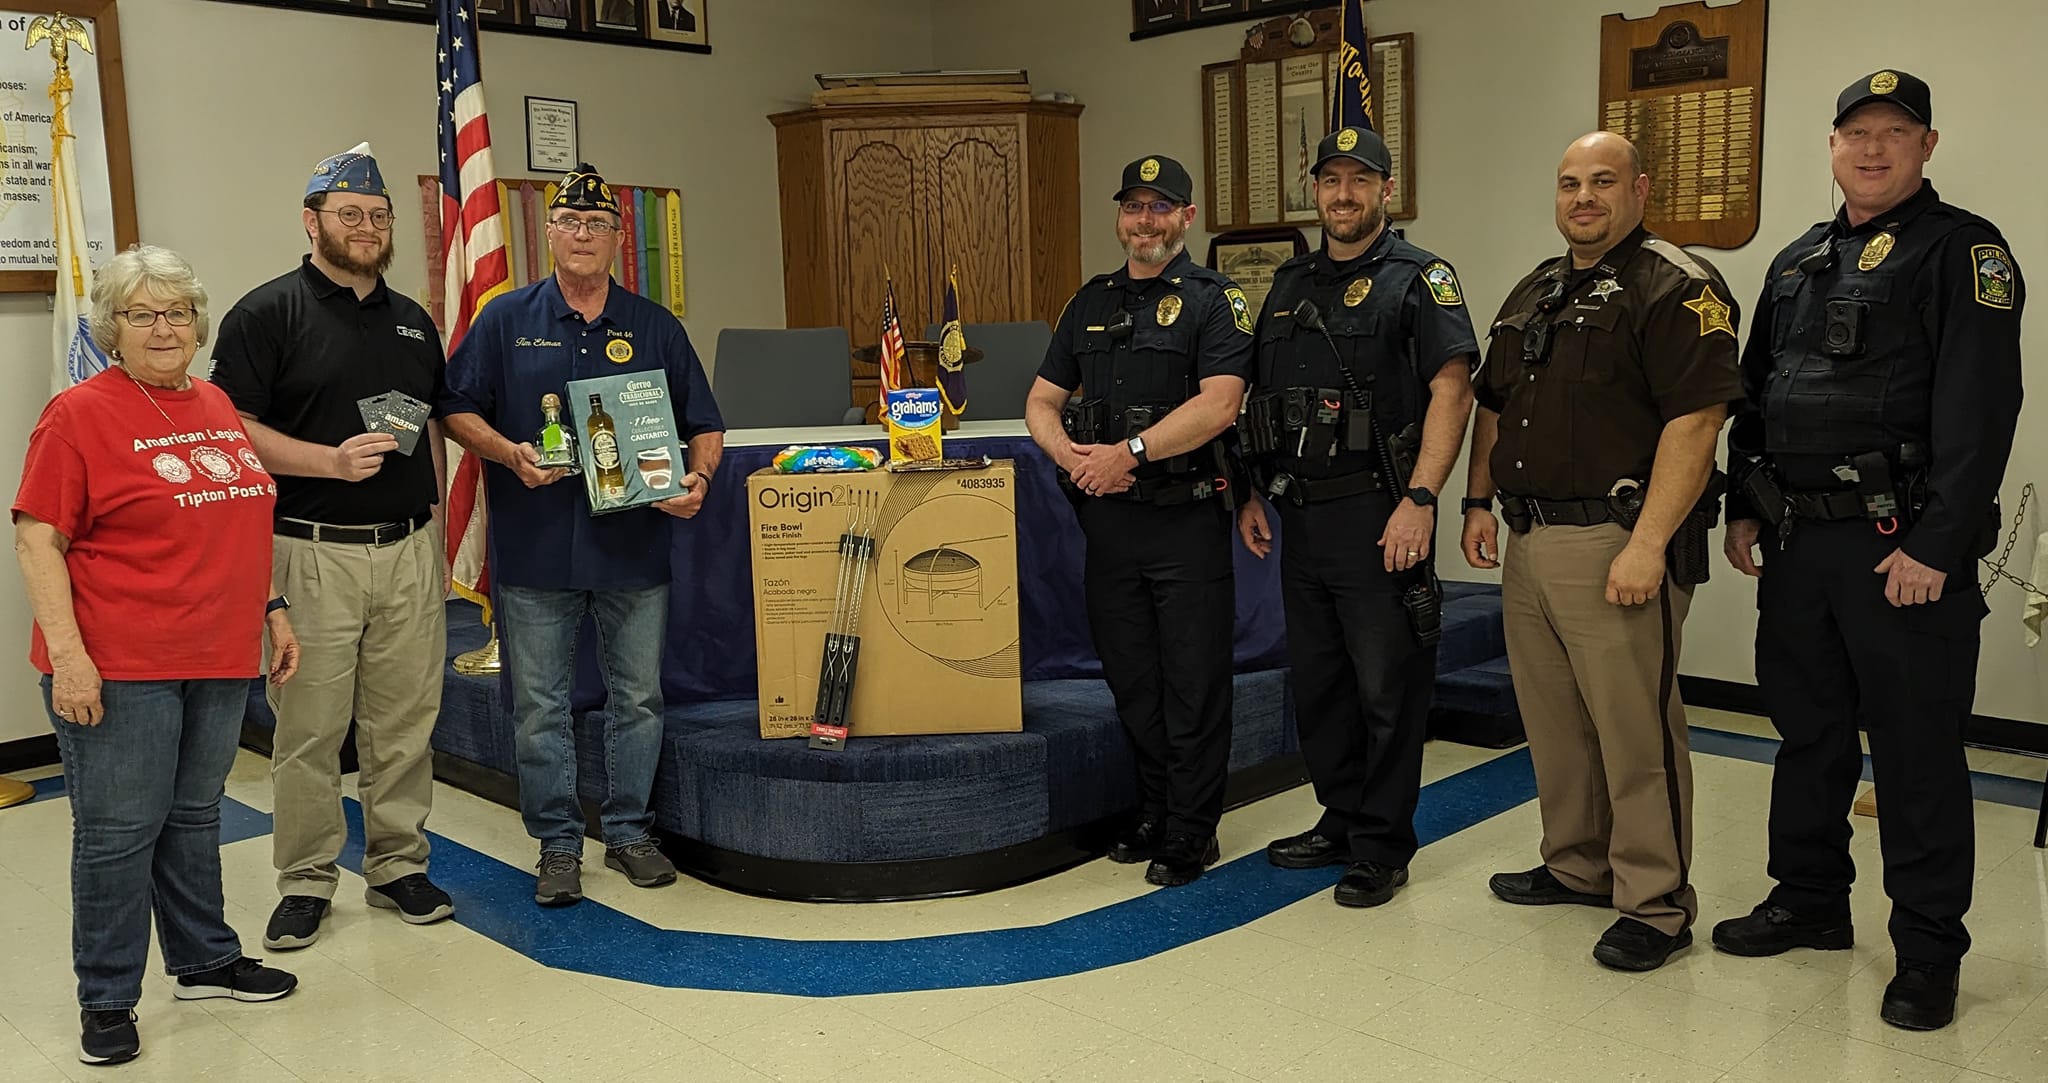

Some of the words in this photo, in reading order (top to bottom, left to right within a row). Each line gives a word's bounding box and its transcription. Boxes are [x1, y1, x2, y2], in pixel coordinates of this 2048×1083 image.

[9, 17, 26, 31] of
[4, 111, 12, 121] of
[12, 159, 20, 169] in
[23, 160, 33, 170] all
[5, 176, 28, 186] state
[30, 176, 46, 186] and
[3, 193, 40, 203] masses;
[33, 239, 50, 249] and
[8, 255, 39, 264] mutual
[607, 329, 623, 338] Post
[624, 330, 633, 338] 46
[891, 400, 938, 421] grahams
[385, 413, 420, 433] amazon
[630, 430, 669, 441] CANTARITO
[133, 432, 206, 452] American
[174, 490, 227, 508] Tipton
[228, 483, 265, 499] Post
[761, 524, 778, 532] Fire
[780, 522, 803, 531] Bowl
[763, 578, 790, 587] Tazón
[797, 588, 817, 596] negro
